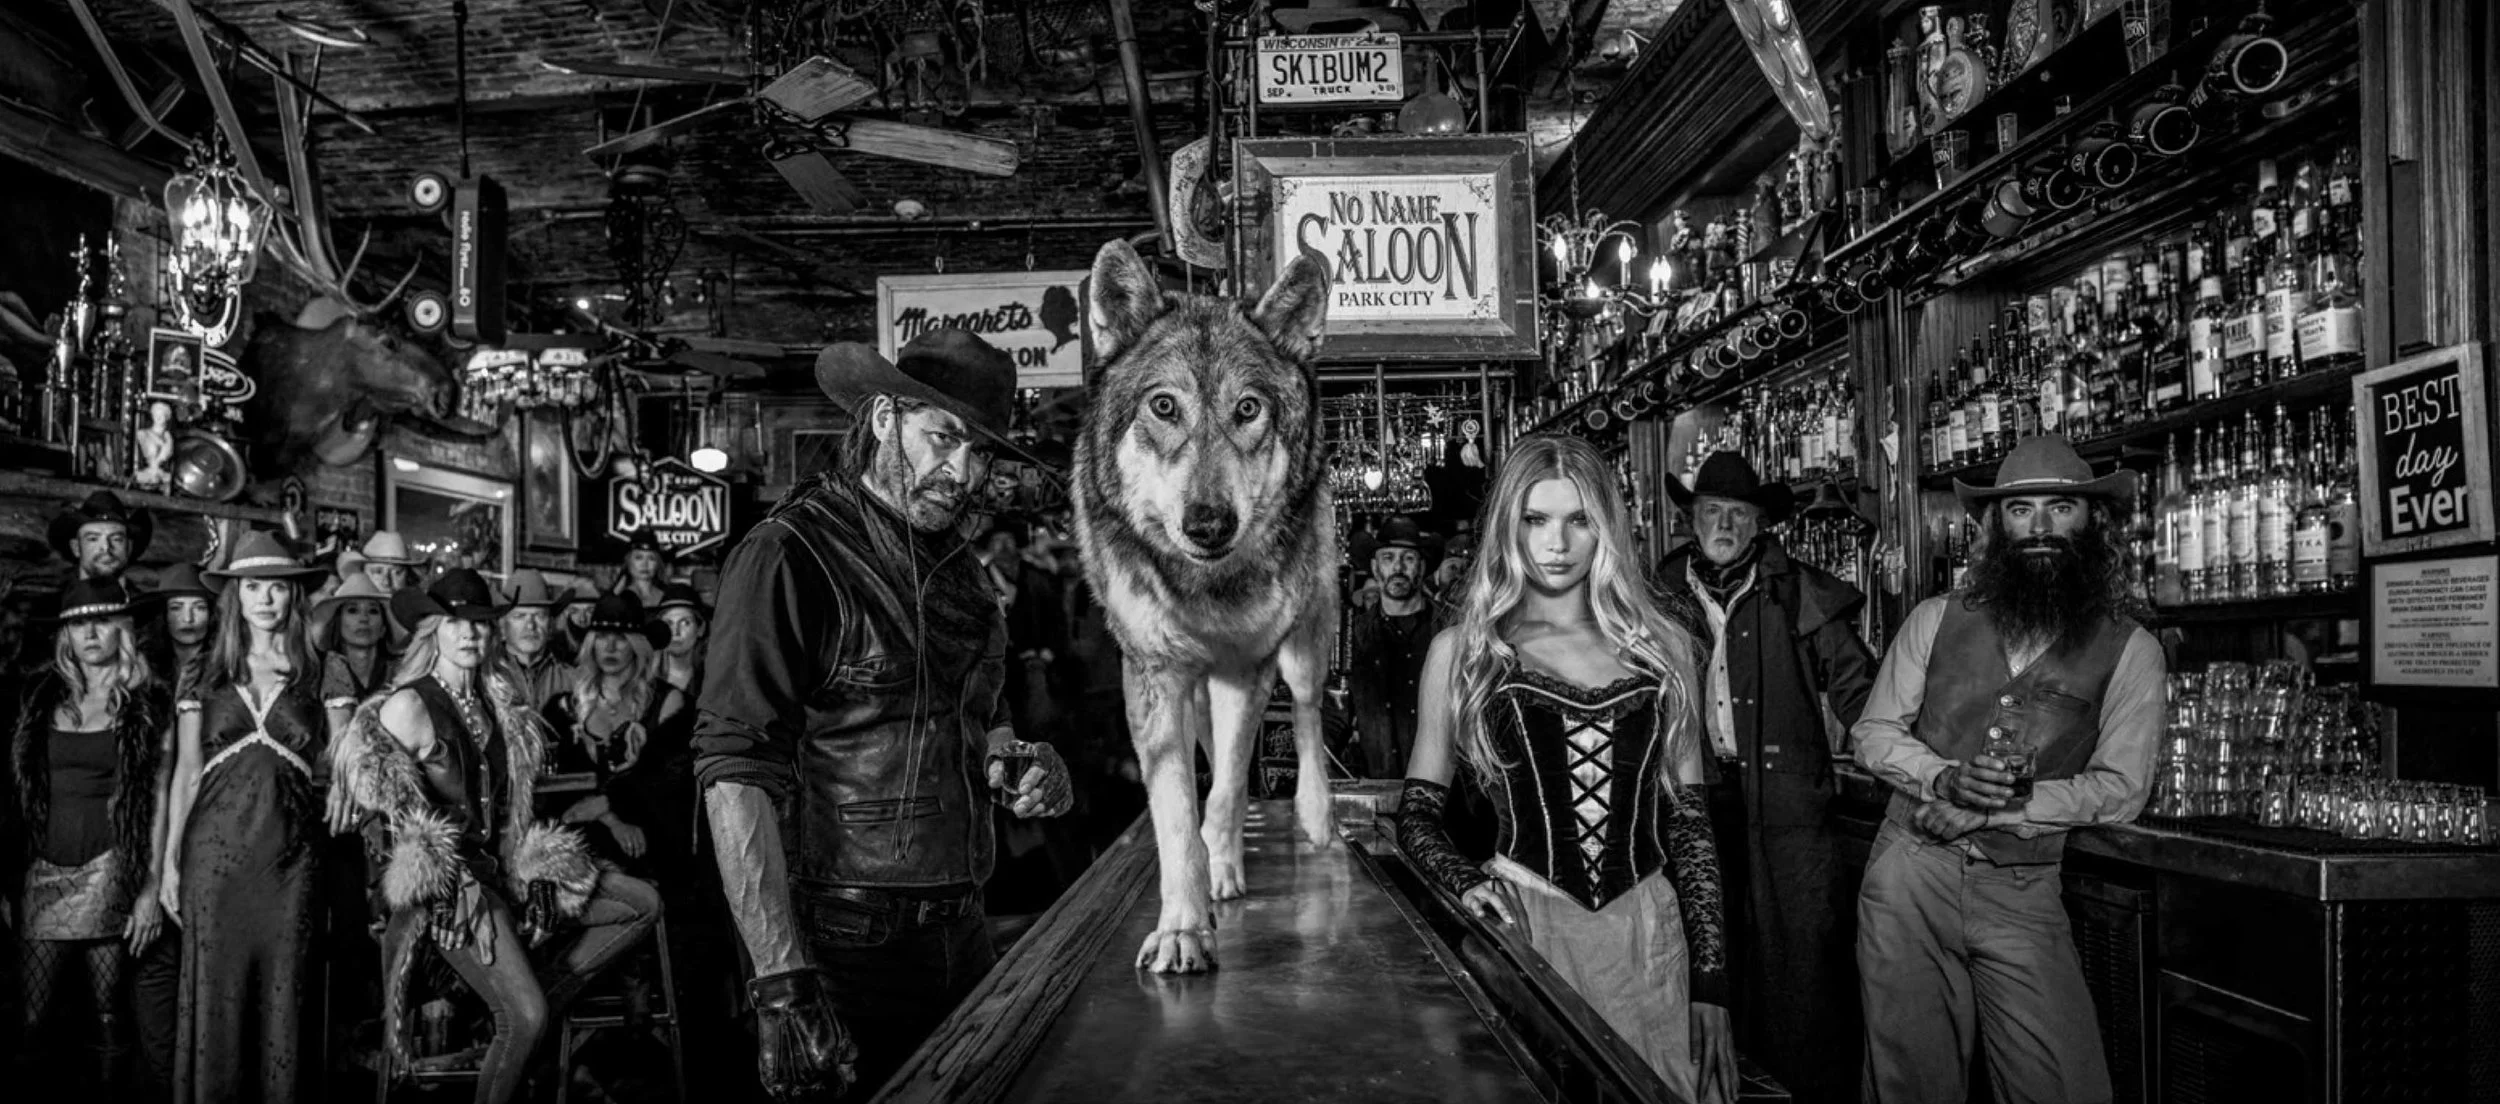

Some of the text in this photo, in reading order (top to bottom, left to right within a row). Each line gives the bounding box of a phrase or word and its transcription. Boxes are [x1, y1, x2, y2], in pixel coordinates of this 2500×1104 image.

[1263, 37, 1338, 49] WISCONSIN
[1272, 51, 1389, 85] SKIBUM2
[1266, 87, 1285, 97] SEP
[1312, 85, 1352, 95] TRUCK
[1328, 189, 1443, 226] NO NAME
[1296, 212, 1480, 301] SALOON
[1338, 290, 1435, 307] PARK CITY
[2381, 373, 2460, 436] BEST
[2395, 431, 2459, 488] day
[617, 483, 723, 532] SALOON
[2389, 484, 2468, 535] Ever
[671, 530, 702, 545] CITY
